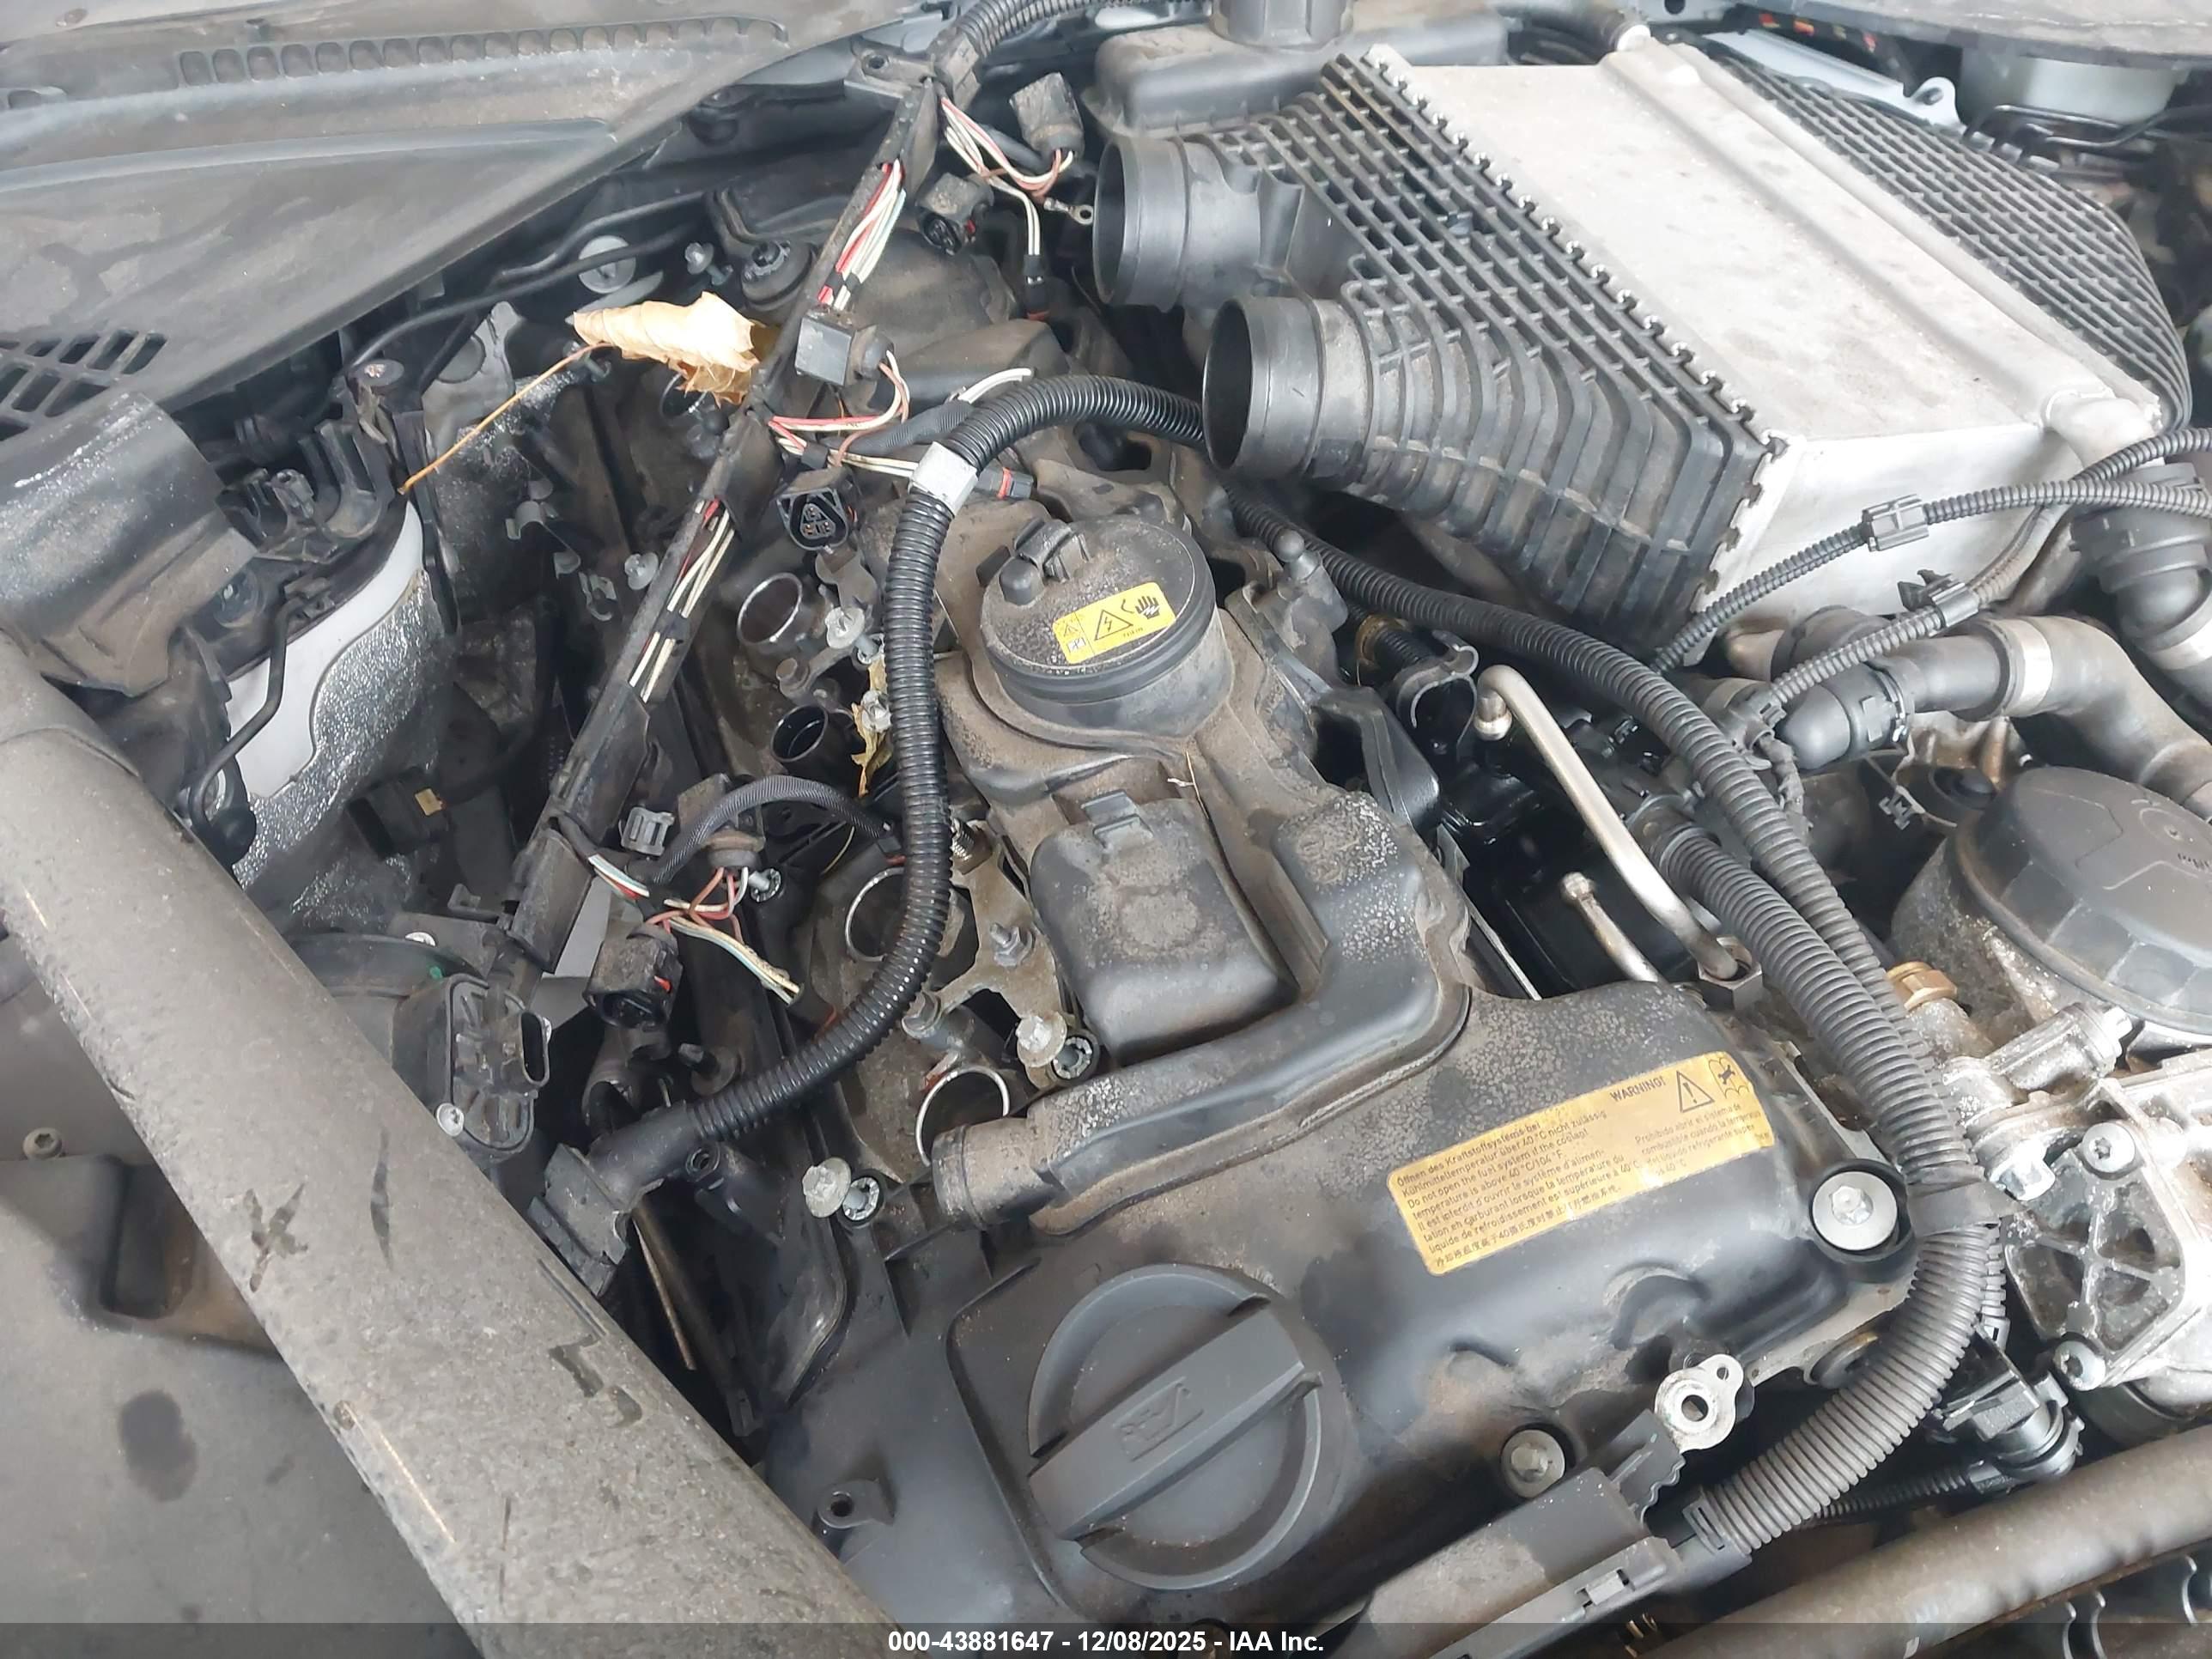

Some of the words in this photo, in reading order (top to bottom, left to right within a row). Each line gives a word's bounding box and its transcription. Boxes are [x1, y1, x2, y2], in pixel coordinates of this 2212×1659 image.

[1609, 1075, 1667, 1102] WARNING!
[1396, 1170, 1426, 1187] Öffnen
[1429, 1164, 1444, 1174] des
[1445, 1128, 1524, 1166] Kraftstoffsystems
[1525, 1121, 1540, 1133] bei
[1401, 1152, 1498, 1198] Kühlmitteltemperatur
[1499, 1142, 1521, 1157] über
[1523, 1135, 1534, 1147] 40
[1535, 1130, 1547, 1140] °C
[1548, 1121, 1571, 1138] nicht
[1407, 1199, 1420, 1209] Do
[1422, 1191, 1437, 1204] not
[1437, 1181, 1460, 1198] open
[1462, 1173, 1477, 1187] the
[1477, 1163, 1497, 1178] fuel
[1498, 1149, 1531, 1174] system
[1532, 1146, 1539, 1156] if
[1540, 1140, 1554, 1152] the
[1556, 1128, 1589, 1147] coolant
[1412, 1190, 1469, 1219] temperature
[1470, 1187, 1479, 1195] is
[1480, 1175, 1506, 1190] above
[1509, 1168, 1520, 1179] 40
[1520, 1156, 1552, 1173] °C/104
[1424, 1226, 1449, 1243] tation
[1451, 1219, 1463, 1231] en
[1463, 1199, 1510, 1226] carburant
[1510, 1185, 1546, 1207] lorsque
[1546, 1181, 1556, 1190] la
[1556, 1158, 1611, 1186] température
[1613, 1154, 1625, 1164] du
[1427, 1216, 1441, 1228] est
[1443, 1201, 1474, 1221] interdit
[1511, 1181, 1522, 1191] le
[1523, 1165, 1562, 1187] système
[1428, 1236, 1460, 1254] liquide
[1462, 1228, 1474, 1240] de
[1474, 1199, 1547, 1235] refroidissement
[1547, 1190, 1561, 1202] est
[1564, 1170, 1612, 1197] supérieure
[1613, 1167, 1620, 1176] à
